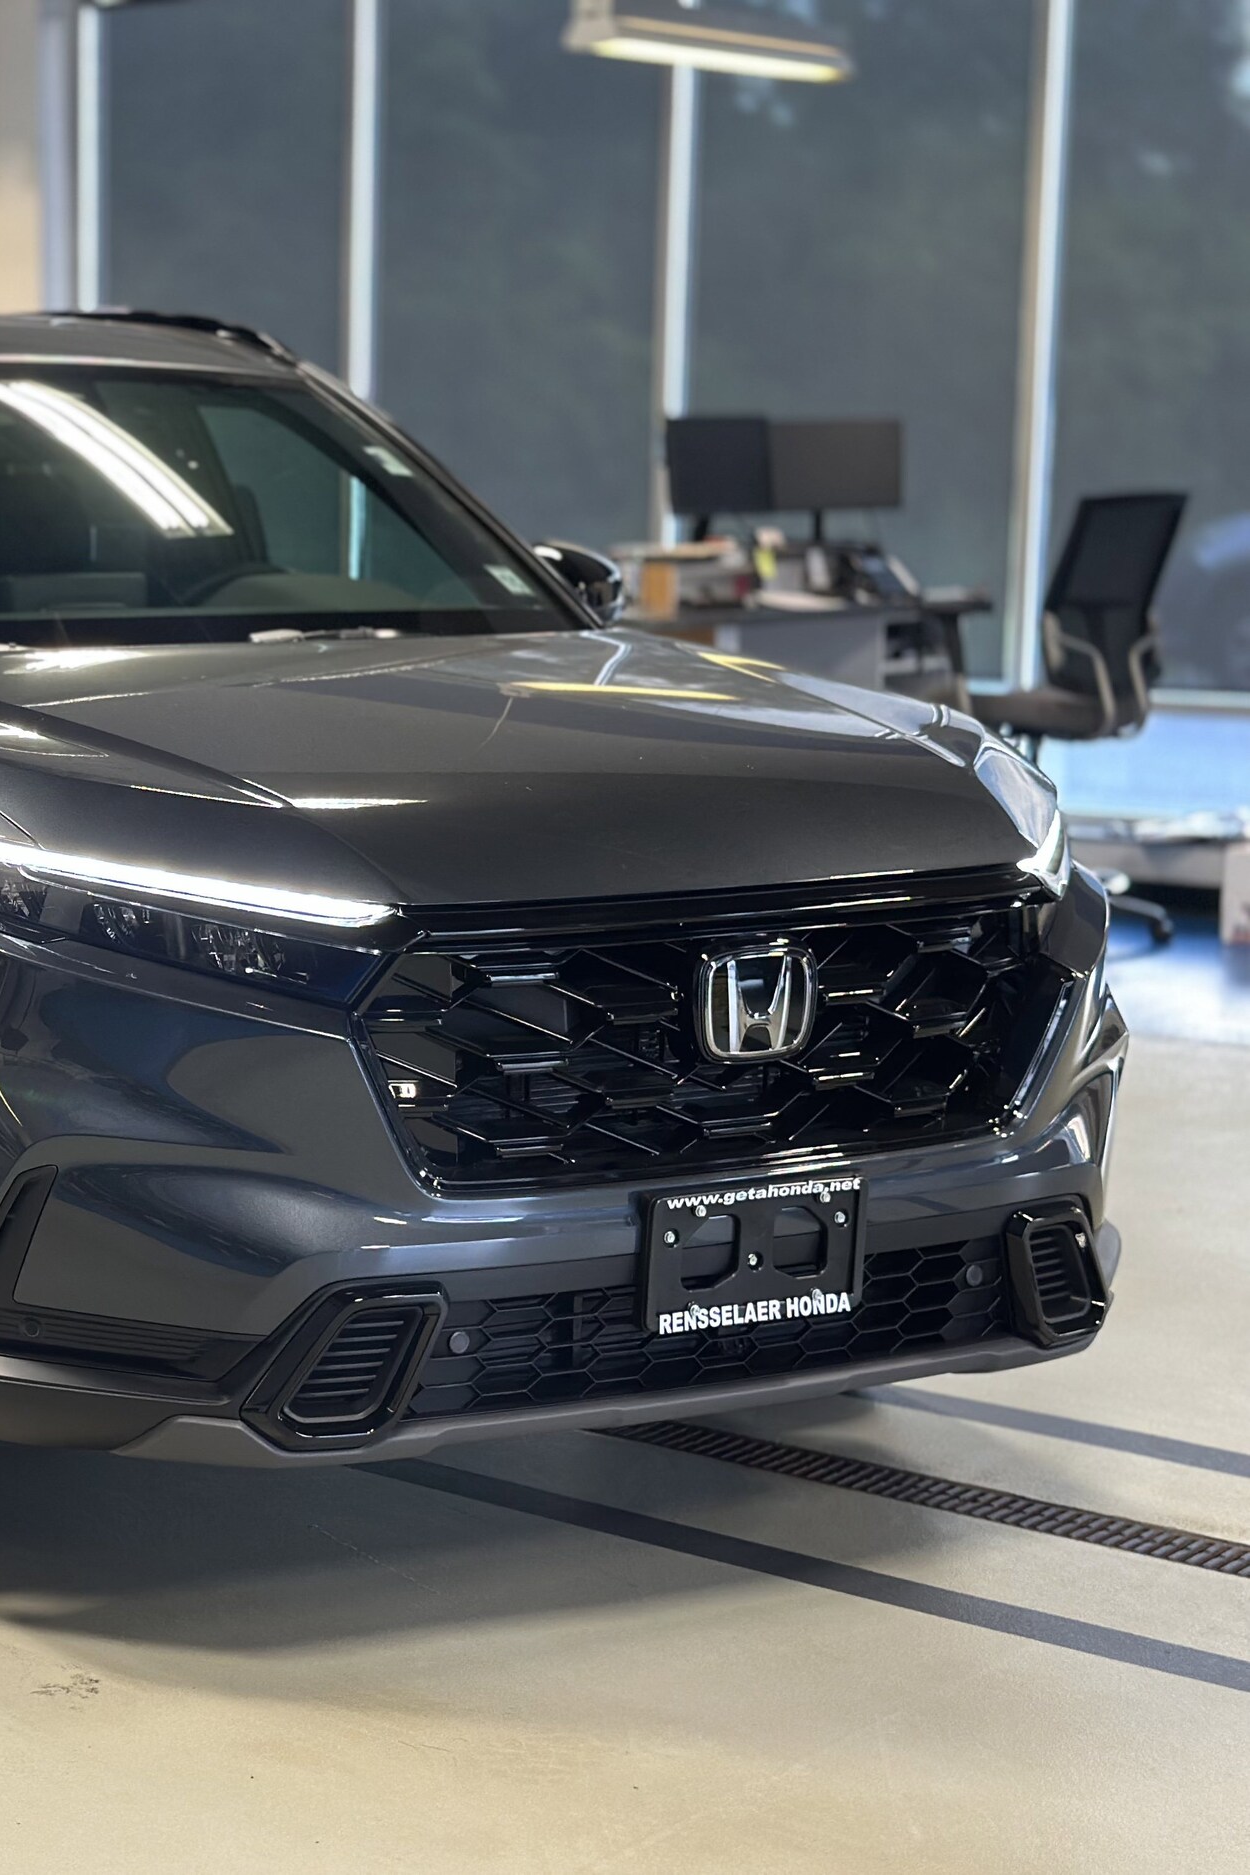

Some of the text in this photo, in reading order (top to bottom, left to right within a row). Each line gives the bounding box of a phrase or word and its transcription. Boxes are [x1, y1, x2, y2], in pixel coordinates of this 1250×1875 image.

[667, 1177, 861, 1210] www.getahonda.net
[659, 1292, 851, 1335] RENSSELAER HONDA
